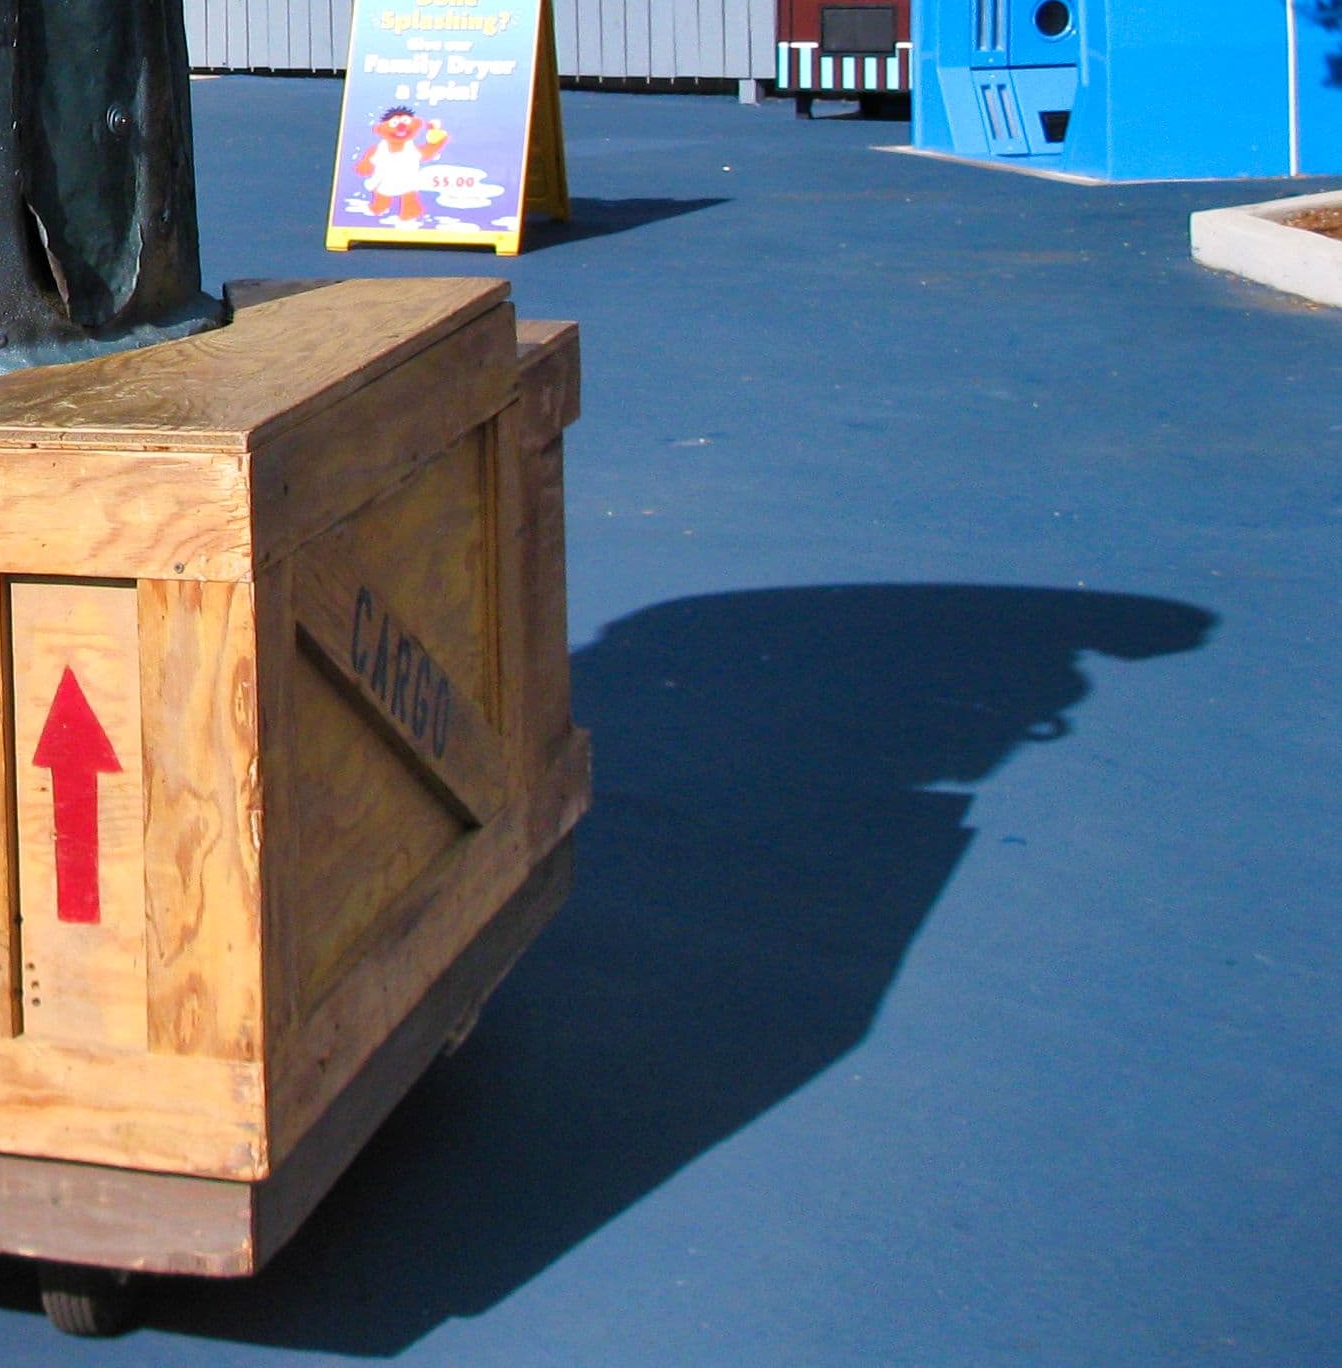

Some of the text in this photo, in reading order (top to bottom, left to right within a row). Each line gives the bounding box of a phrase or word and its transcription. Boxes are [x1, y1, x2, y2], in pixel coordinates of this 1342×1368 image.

[380, 8, 511, 37] Splashing?
[364, 53, 518, 81] Family Dryer
[432, 175, 475, 188] $5.00
[352, 585, 450, 759] CARGO
